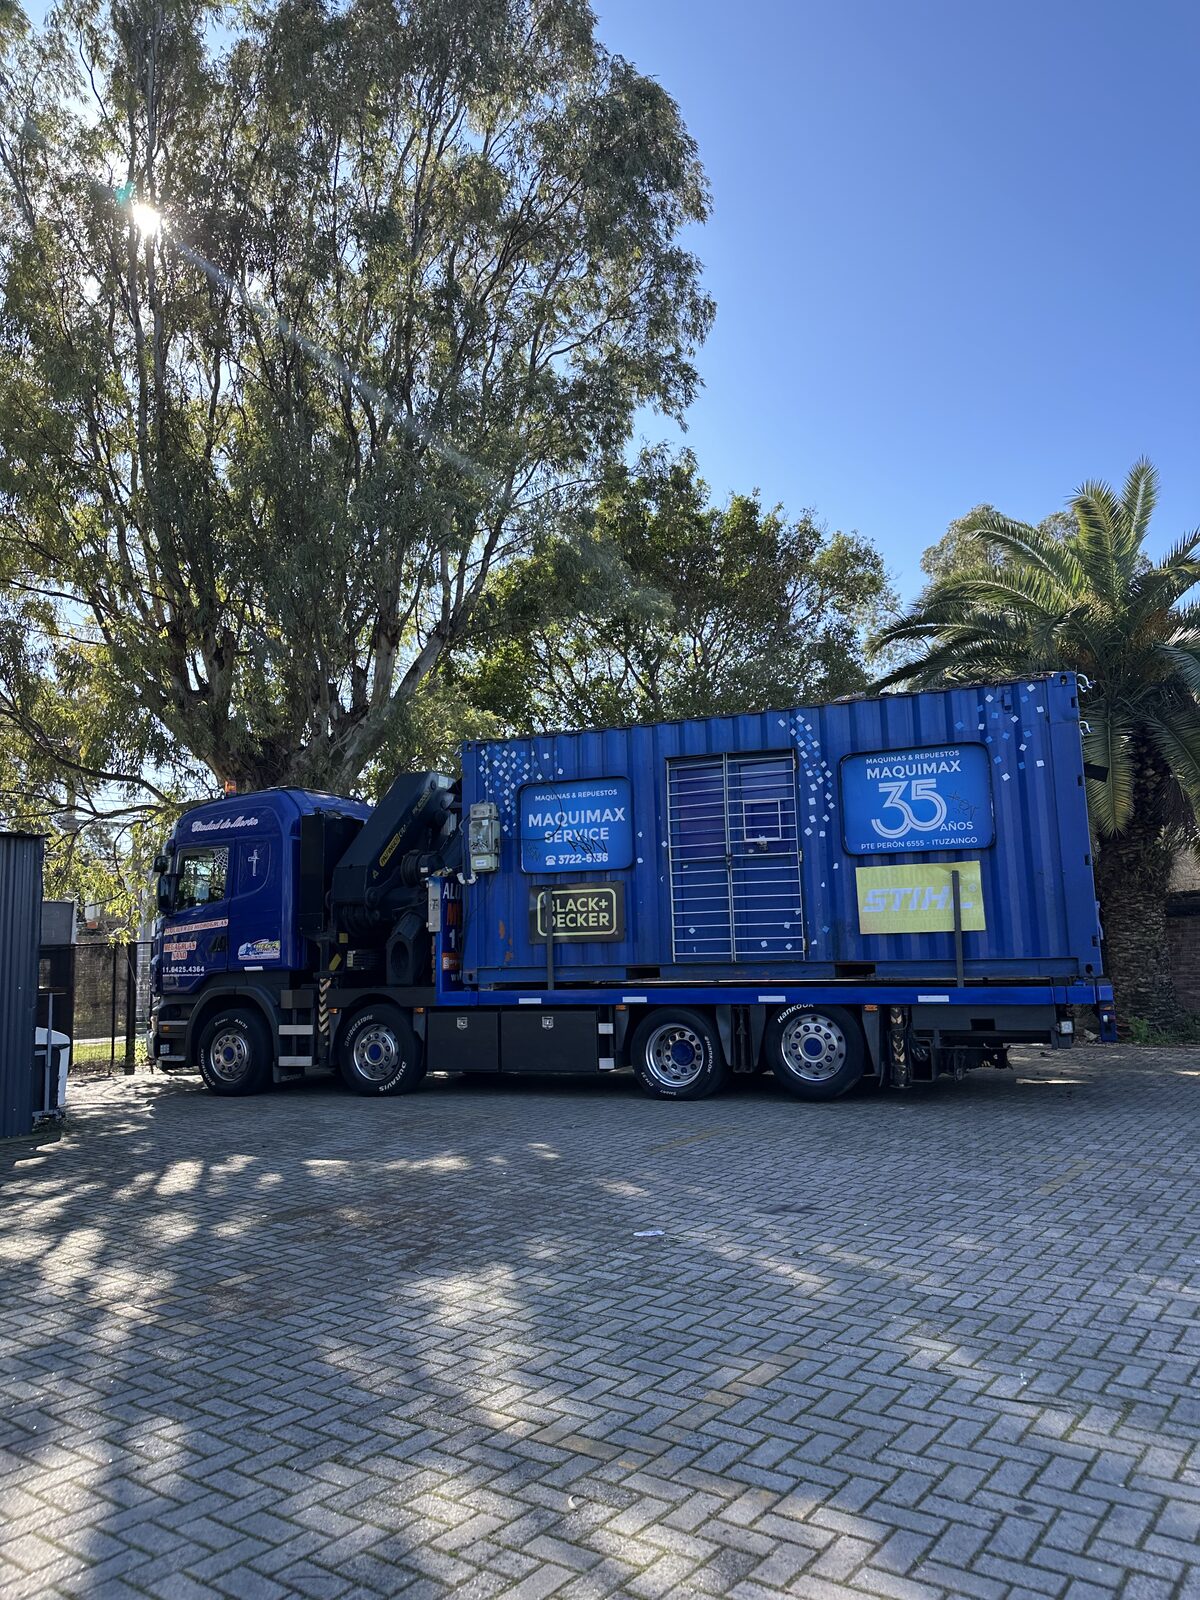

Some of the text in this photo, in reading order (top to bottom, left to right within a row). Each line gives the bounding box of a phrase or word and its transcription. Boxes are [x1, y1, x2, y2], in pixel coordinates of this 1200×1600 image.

[866, 755, 907, 764] MAQUINAS
[914, 750, 960, 760] REPUESTOS
[866, 760, 961, 780] MAQUIMAX
[535, 789, 617, 802] MAQUINAS & REPUESTOS
[871, 778, 948, 839] 35
[528, 807, 625, 828] MAQUIMAX
[939, 820, 974, 832] AÑOS
[544, 827, 609, 844] SERVICE
[861, 842, 875, 850] PTE
[906, 839, 925, 848] 6555
[931, 836, 978, 846] ITUZAINGO
[378, 1060, 408, 1092] DURAVIS
